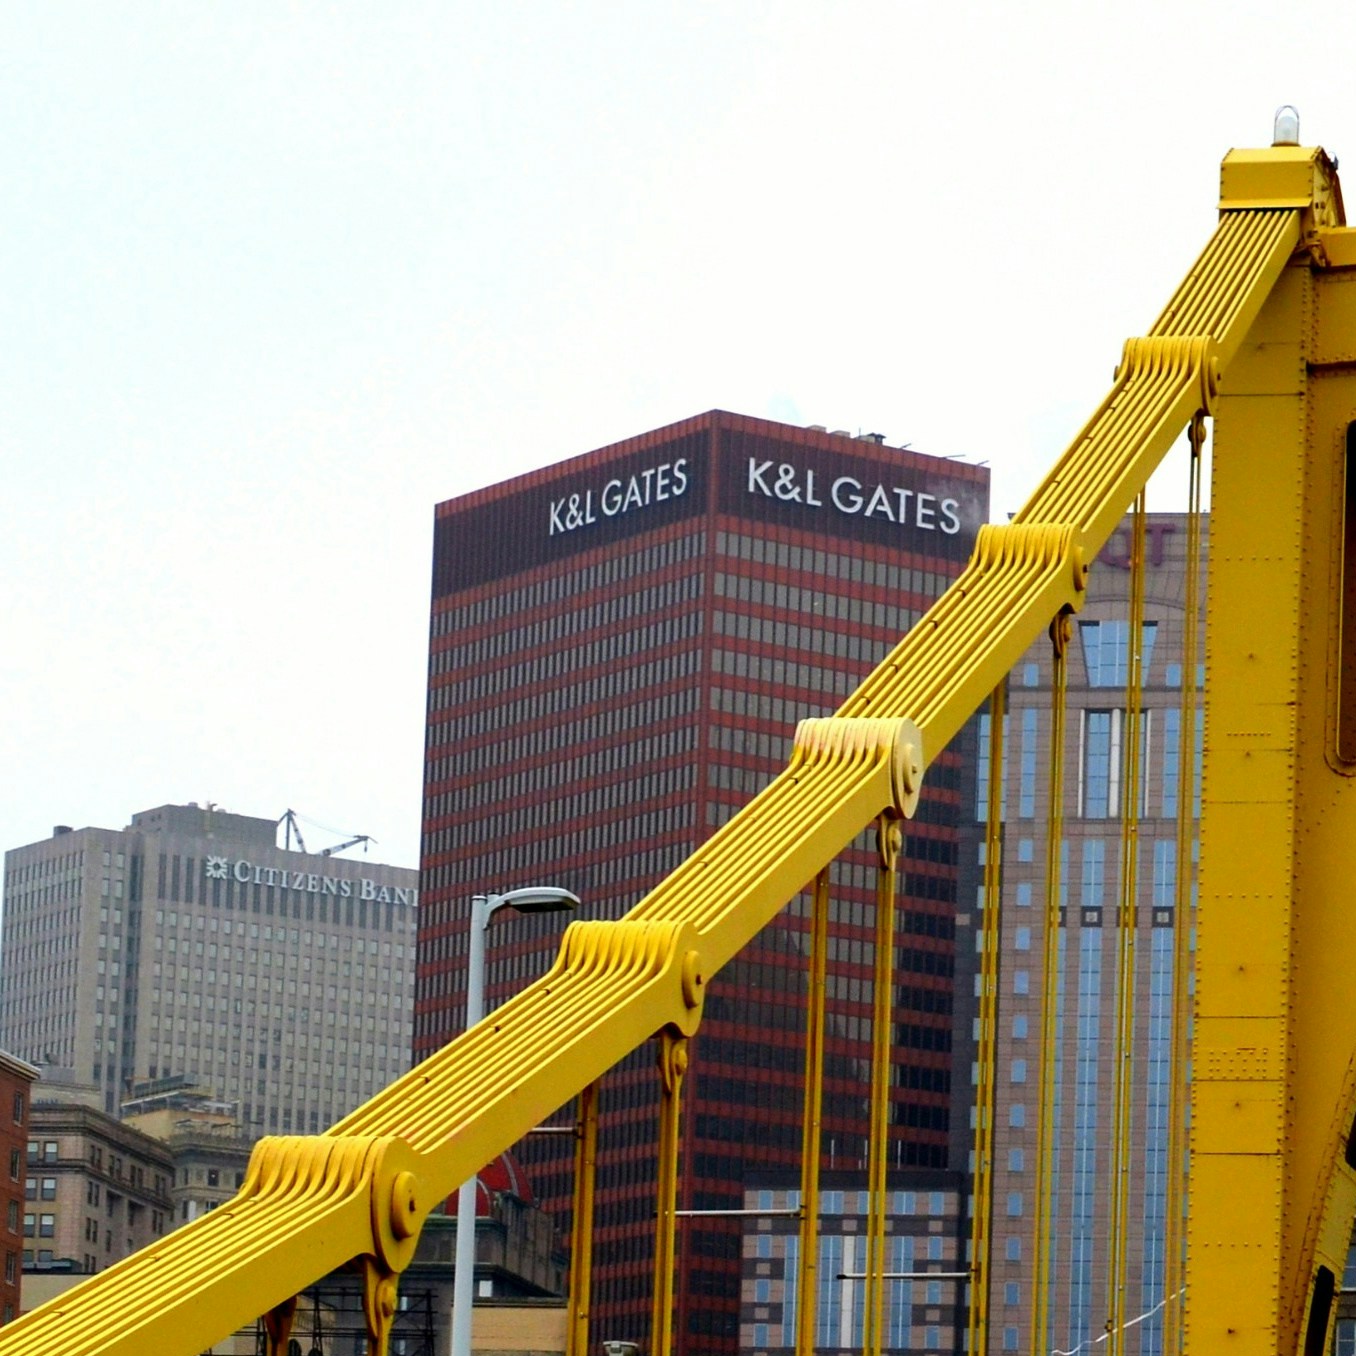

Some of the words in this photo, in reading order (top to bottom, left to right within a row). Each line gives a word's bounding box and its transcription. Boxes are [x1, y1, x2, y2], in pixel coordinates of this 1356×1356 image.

[549, 489, 596, 536] K&L
[601, 458, 687, 516] GATES
[748, 457, 822, 507] K&L
[831, 476, 960, 535] GATES
[233, 859, 352, 898] CITIZENS
